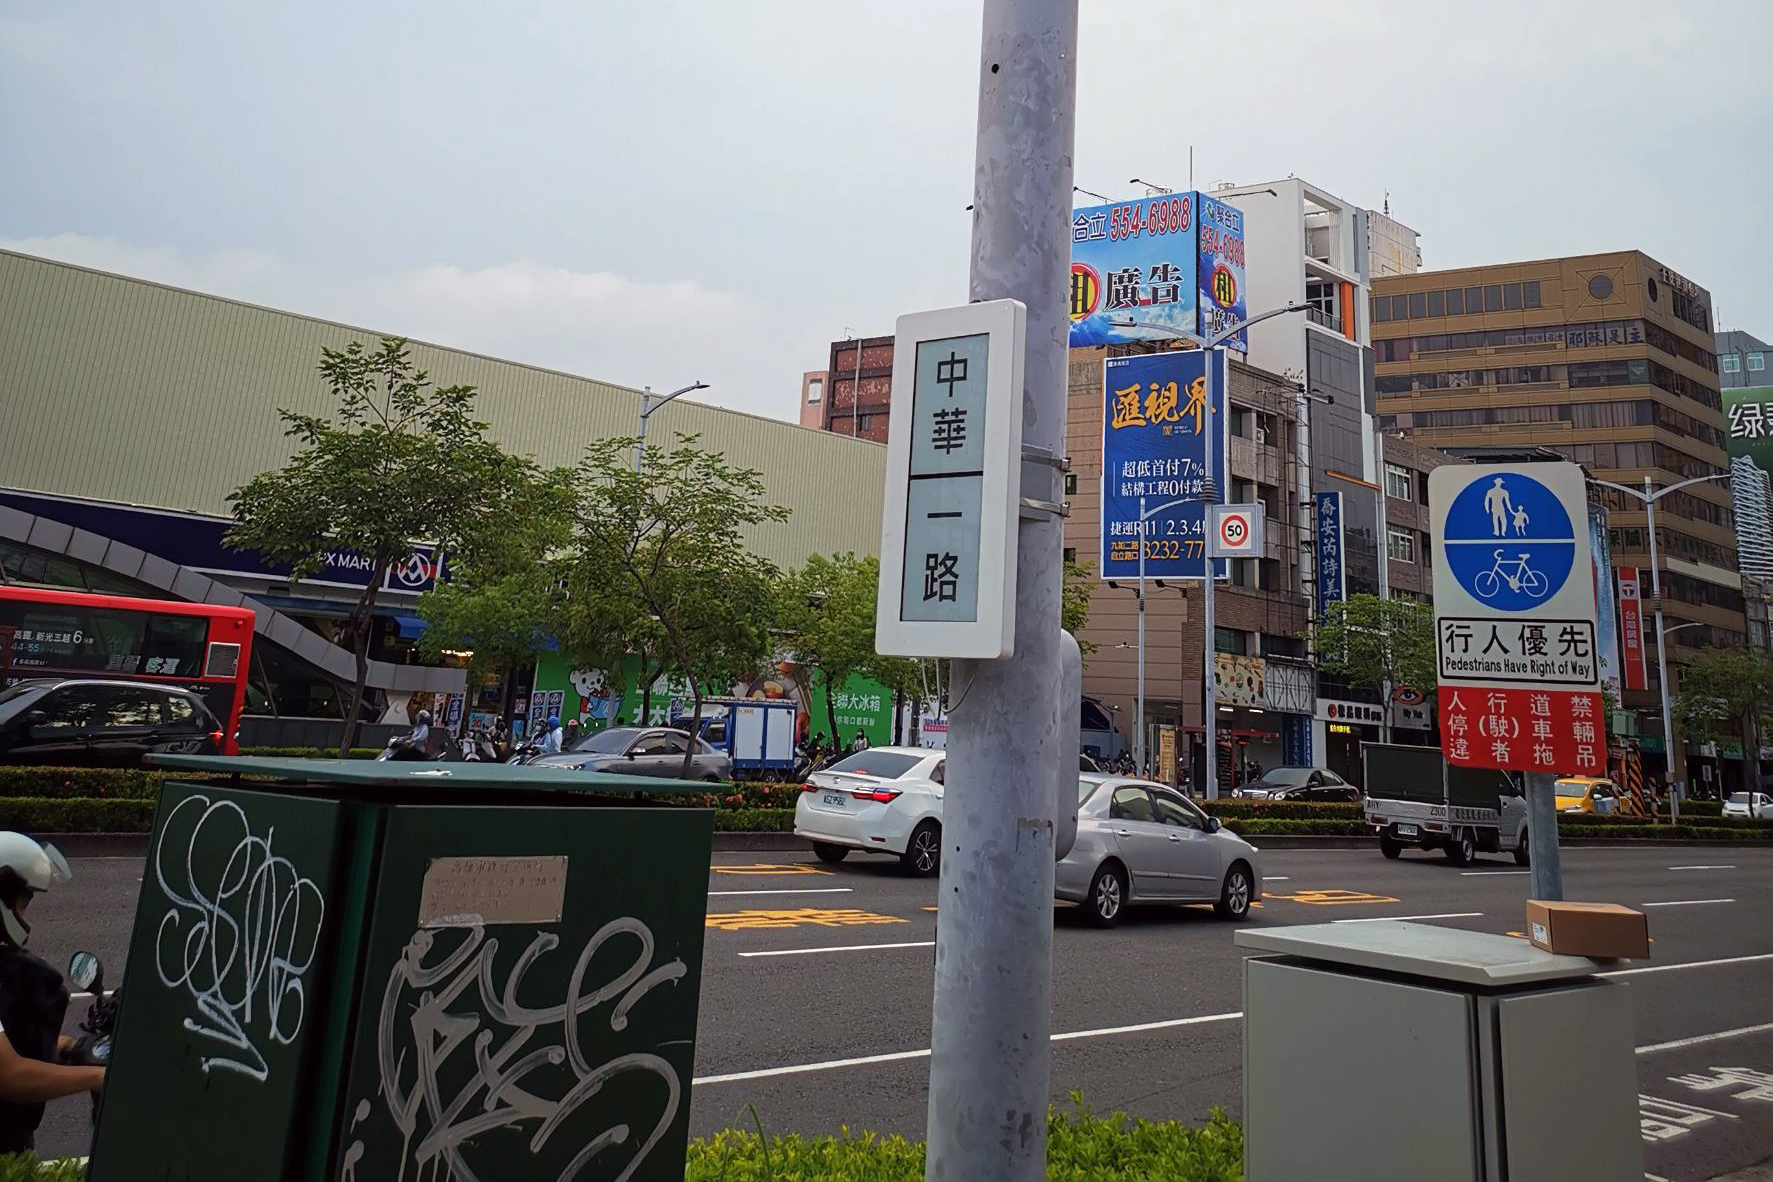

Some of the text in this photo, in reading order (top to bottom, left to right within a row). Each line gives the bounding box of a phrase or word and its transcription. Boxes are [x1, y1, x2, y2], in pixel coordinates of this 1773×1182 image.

[1110, 196, 1191, 241] 554-6988
[1104, 264, 1184, 311] 廣告
[1111, 376, 1216, 436] 匯視界
[1728, 402, 1773, 438] 绿
[922, 351, 969, 603] 中華一路
[1121, 458, 1205, 478] 超低首付7%
[1120, 479, 1205, 497] 結構工程0付款
[1110, 519, 1156, 536] 捷運R11
[1227, 524, 1243, 537] 50
[72, 629, 84, 645] 6
[1445, 623, 1590, 658] 行人優先
[1445, 656, 1590, 679] Pedestrians Have Right of Way
[1430, 806, 1446, 817] 2300
